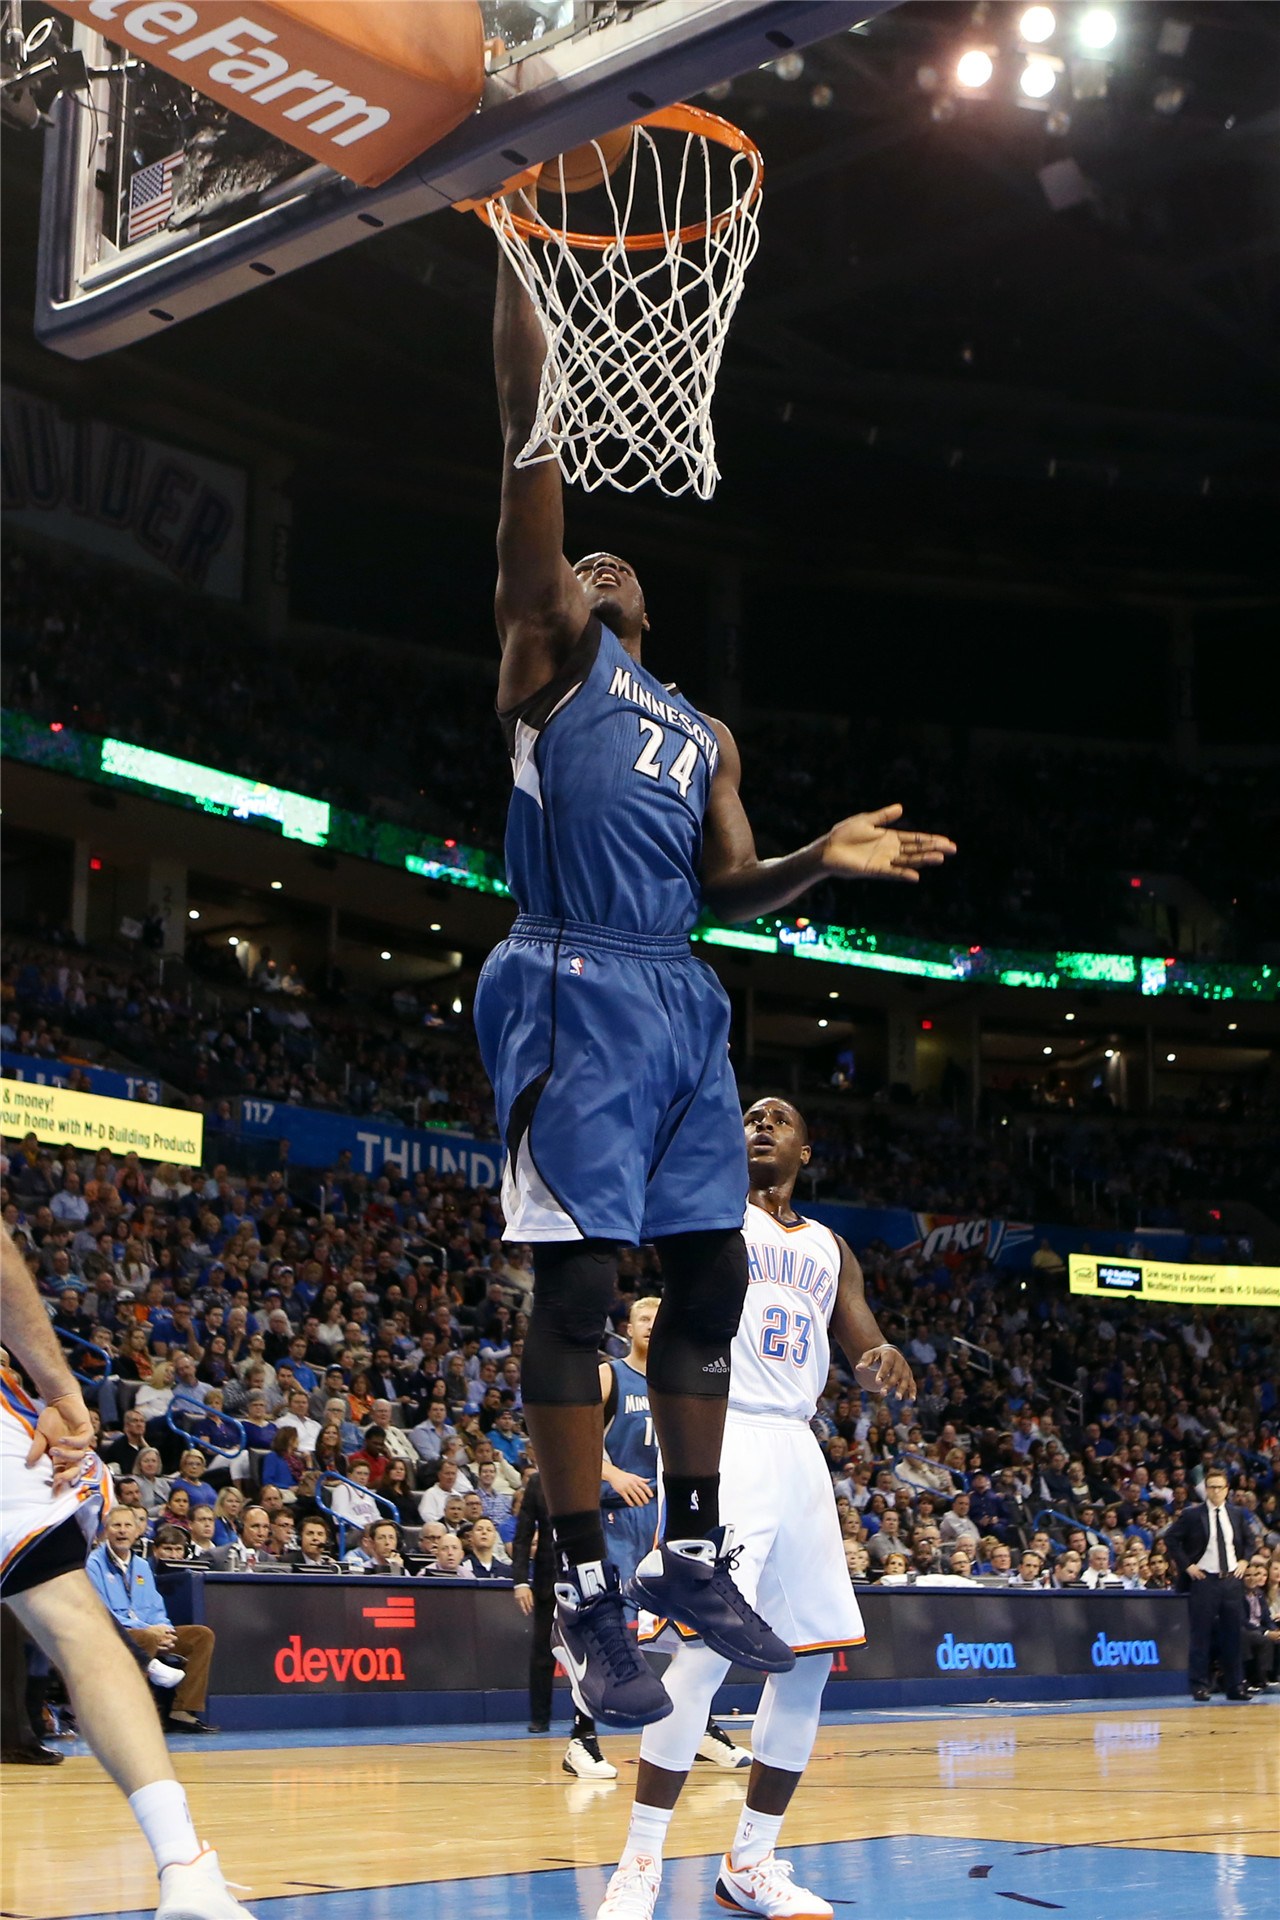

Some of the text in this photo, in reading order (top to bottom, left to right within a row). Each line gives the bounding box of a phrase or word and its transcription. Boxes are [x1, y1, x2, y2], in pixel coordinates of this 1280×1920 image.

[632, 716, 694, 799] 24
[3, 1088, 54, 1113] & money!
[243, 1100, 275, 1125] 117
[24, 1111, 54, 1132] home
[58, 1118, 80, 1136] with
[85, 1121, 105, 1139] M-D
[108, 1125, 150, 1149] Building
[153, 1133, 196, 1154] Products
[356, 1131, 503, 1190] THUND
[760, 1304, 814, 1369] 23
[273, 1635, 406, 1683] devon
[936, 1632, 1017, 1671] devon
[1091, 1631, 1161, 1667] devon
